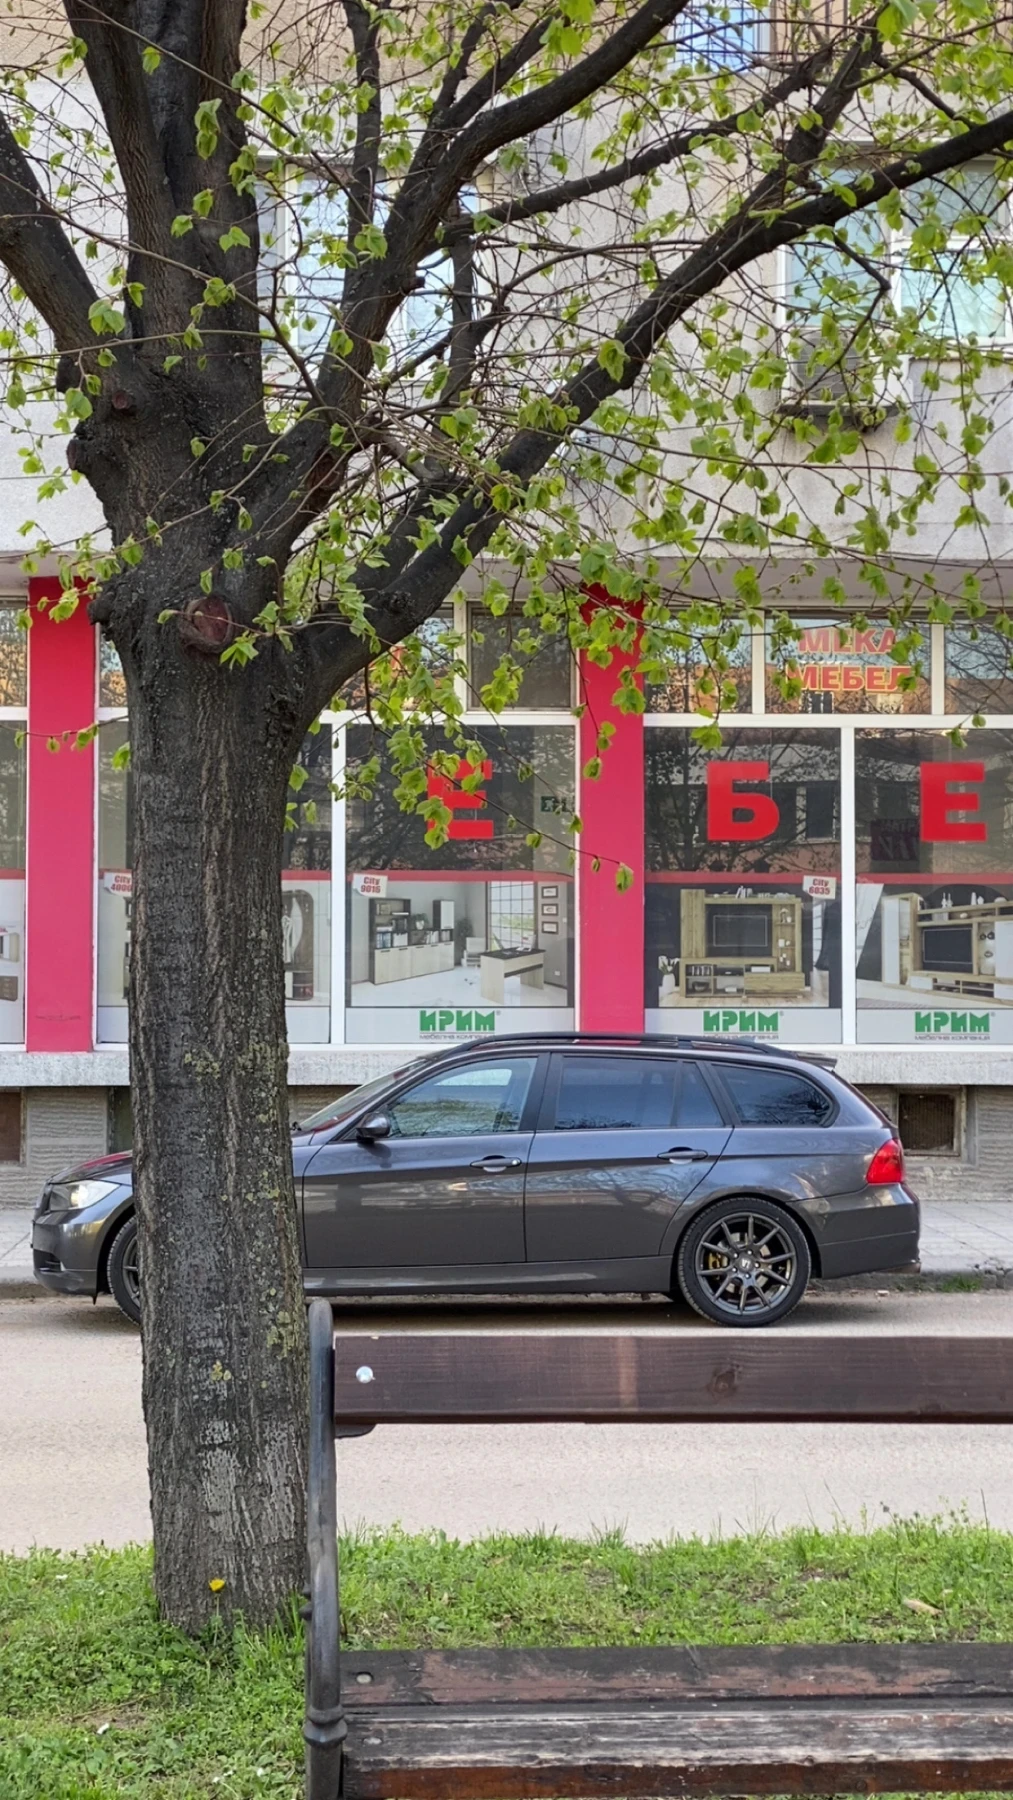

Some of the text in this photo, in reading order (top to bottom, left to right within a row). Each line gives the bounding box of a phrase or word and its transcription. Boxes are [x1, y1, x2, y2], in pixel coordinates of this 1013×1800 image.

[798, 627, 898, 654] МЕКА
[707, 761, 780, 841] Б
[920, 762, 986, 842] Е
[361, 885, 381, 893] 9015
[364, 876, 381, 885] City
[813, 879, 829, 888] City
[420, 1010, 495, 1031] ИРИМ
[703, 1010, 779, 1031] ИРИМ
[915, 1011, 990, 1032] ИРИМ
